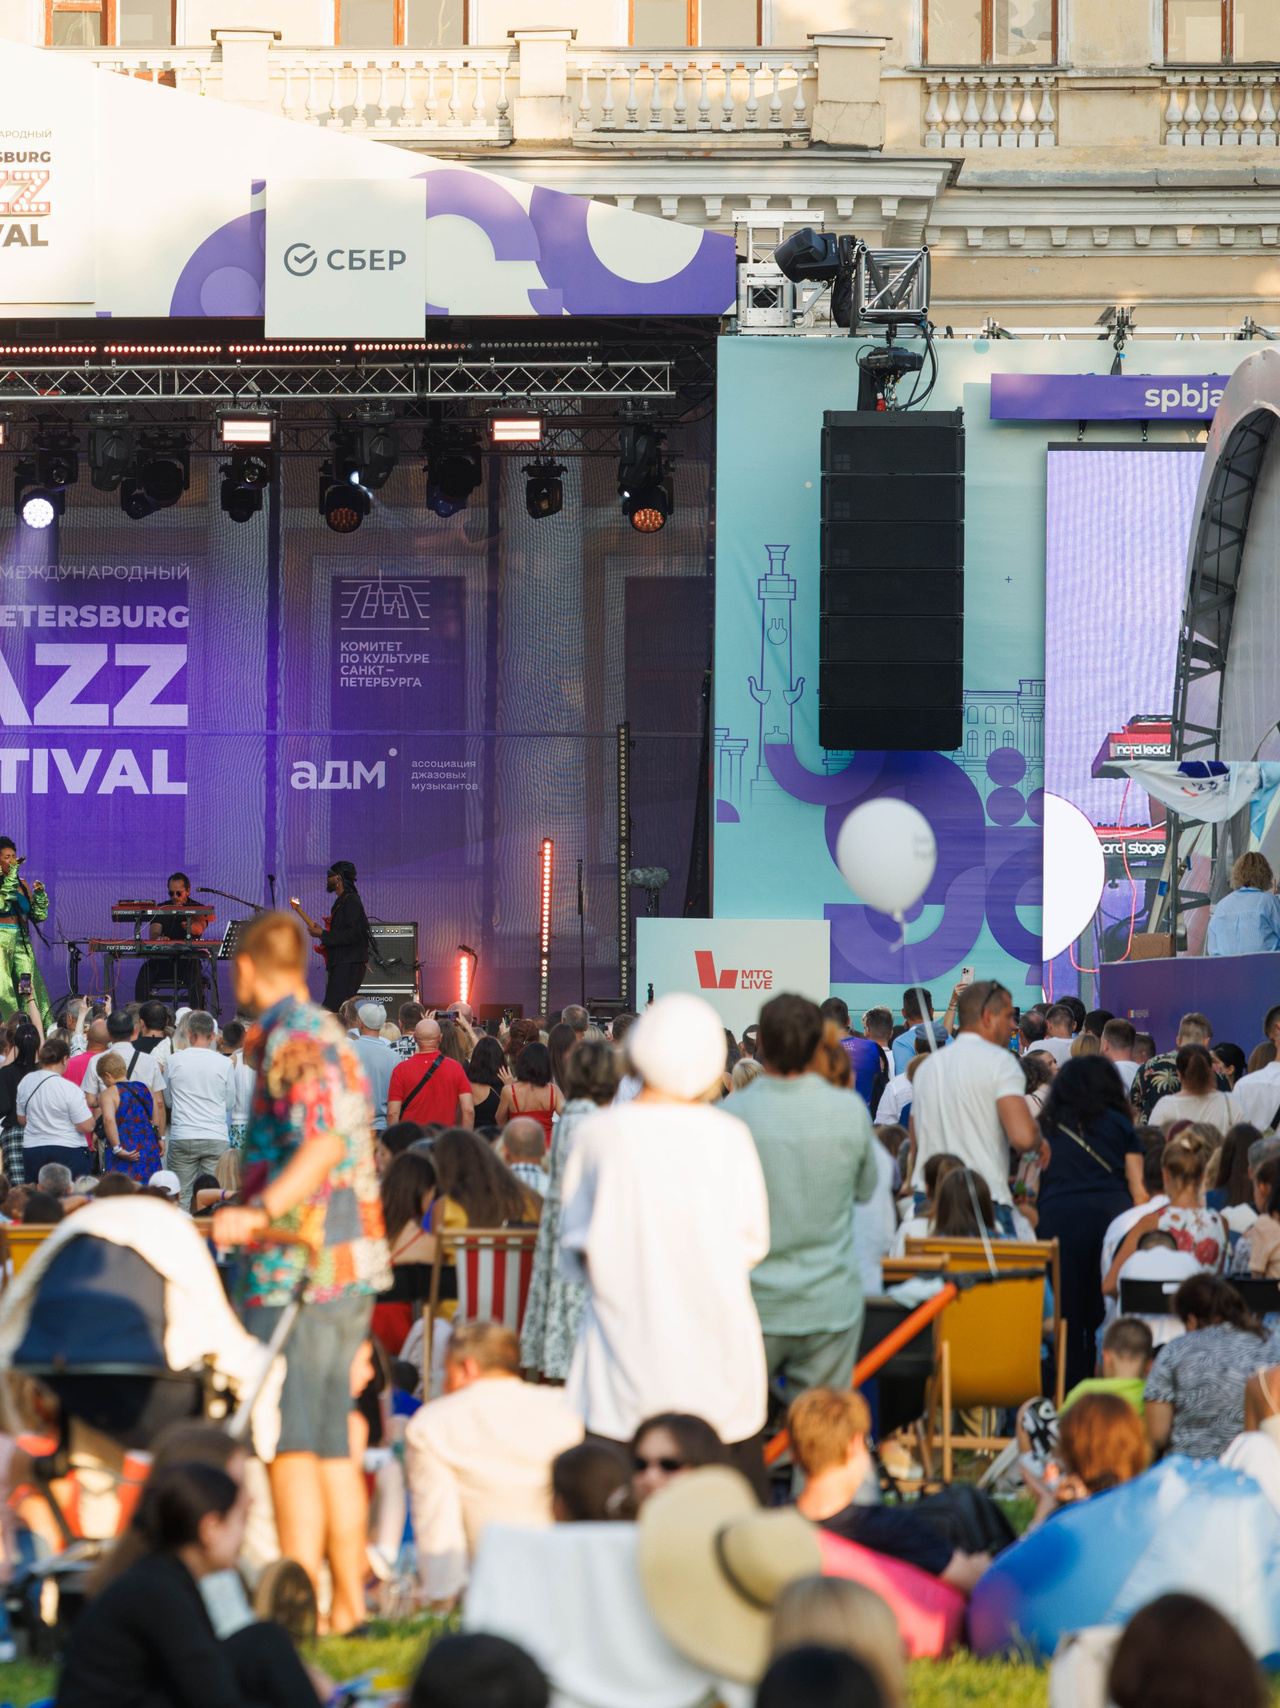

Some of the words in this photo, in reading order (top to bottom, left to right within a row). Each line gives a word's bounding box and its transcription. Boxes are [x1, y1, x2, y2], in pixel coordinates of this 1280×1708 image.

[327, 249, 407, 271] СБЕР
[341, 642, 402, 651] КОМИТЕТ
[341, 654, 359, 663] ПО
[363, 654, 430, 663] КУЛЬТУРЕ
[341, 677, 422, 687] ПЕТЕРБУРГА
[1143, 744, 1166, 754] lead
[411, 760, 476, 769] ассоциация
[411, 771, 467, 779] джазовых
[411, 783, 479, 791] музыкантов
[1102, 842, 1126, 854] ord
[1128, 842, 1166, 856] stage
[741, 980, 773, 989] LIVE
